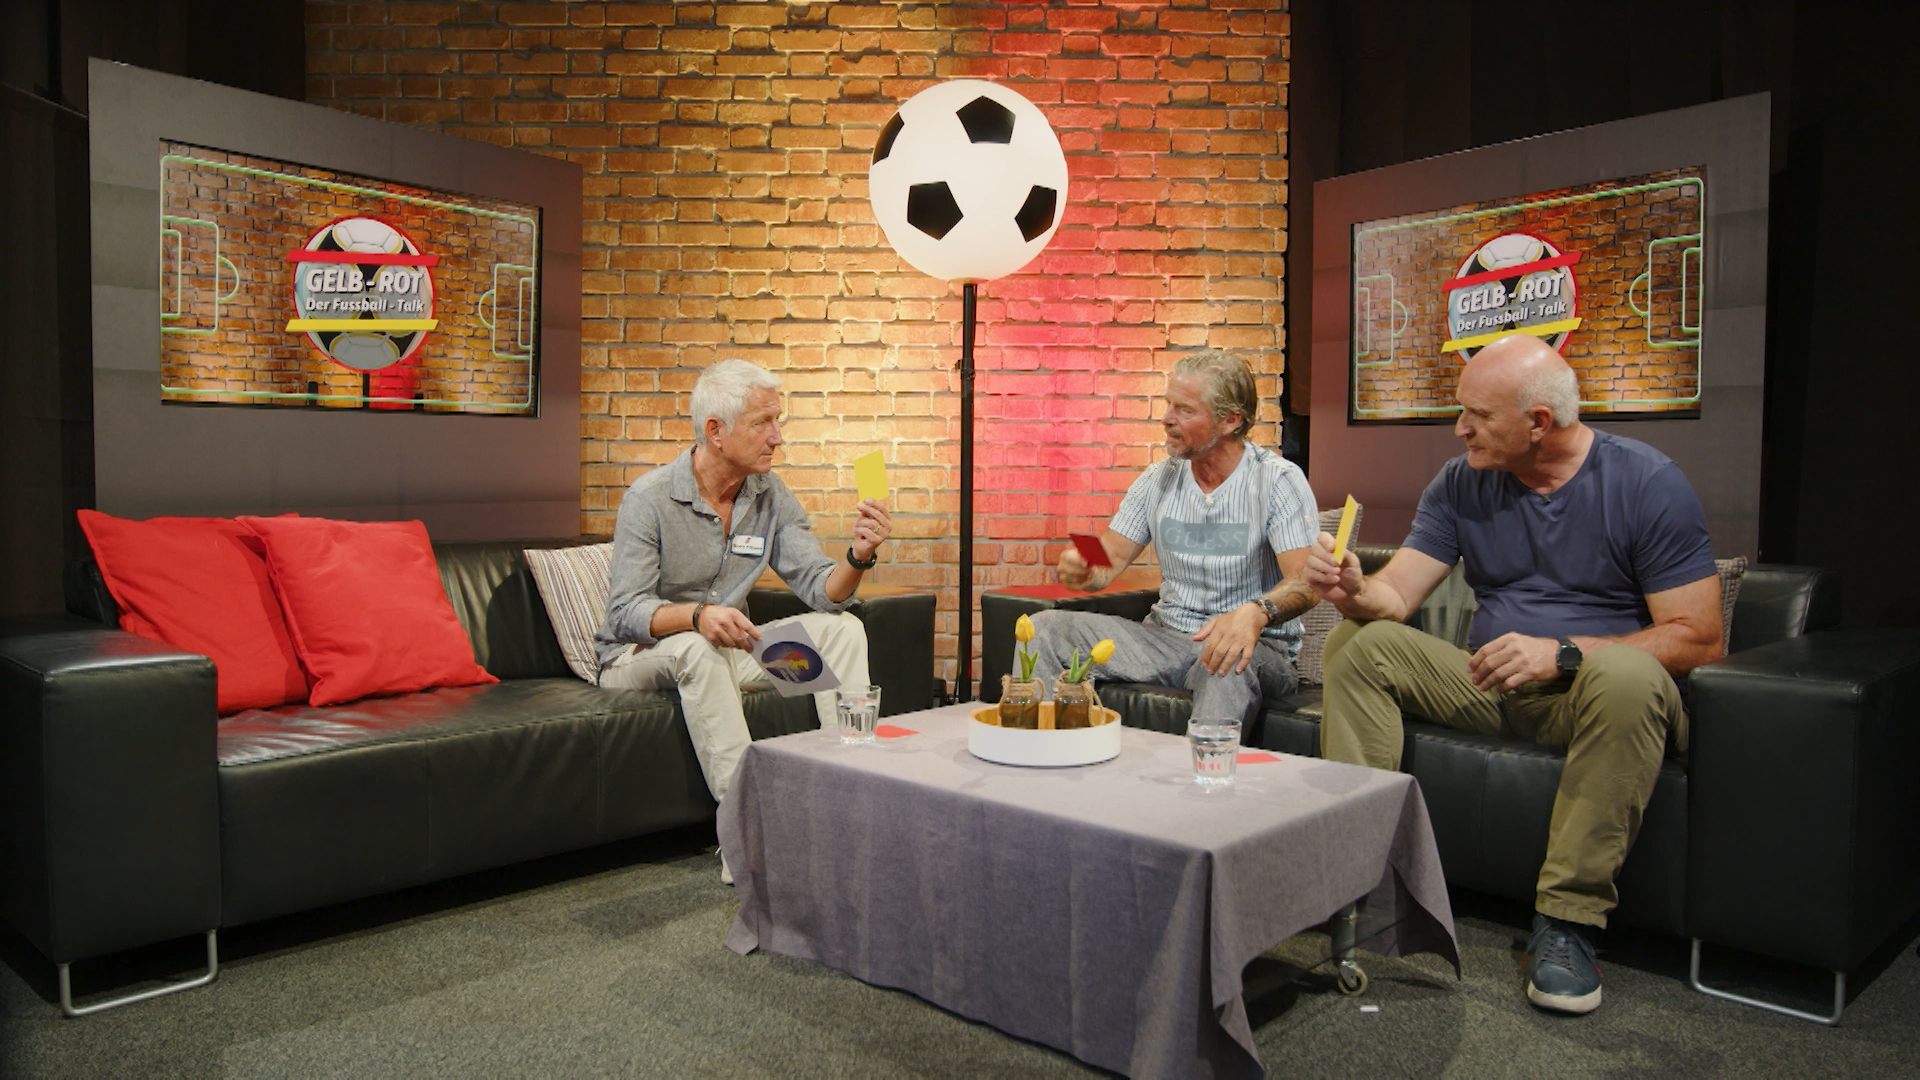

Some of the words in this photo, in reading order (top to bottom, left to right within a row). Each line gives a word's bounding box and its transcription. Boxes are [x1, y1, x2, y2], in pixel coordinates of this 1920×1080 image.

[306, 268, 364, 293] GELB
[378, 271, 424, 294] ROT
[1457, 285, 1507, 315] GELB
[1520, 273, 1565, 303] ROT
[305, 297, 331, 312] Der
[332, 298, 389, 313] Fussball
[397, 299, 425, 313] Talk
[1456, 320, 1477, 333] Der
[1479, 307, 1529, 328] Fussball
[1539, 301, 1568, 317] Talk
[1164, 526, 1247, 550] GUESS
